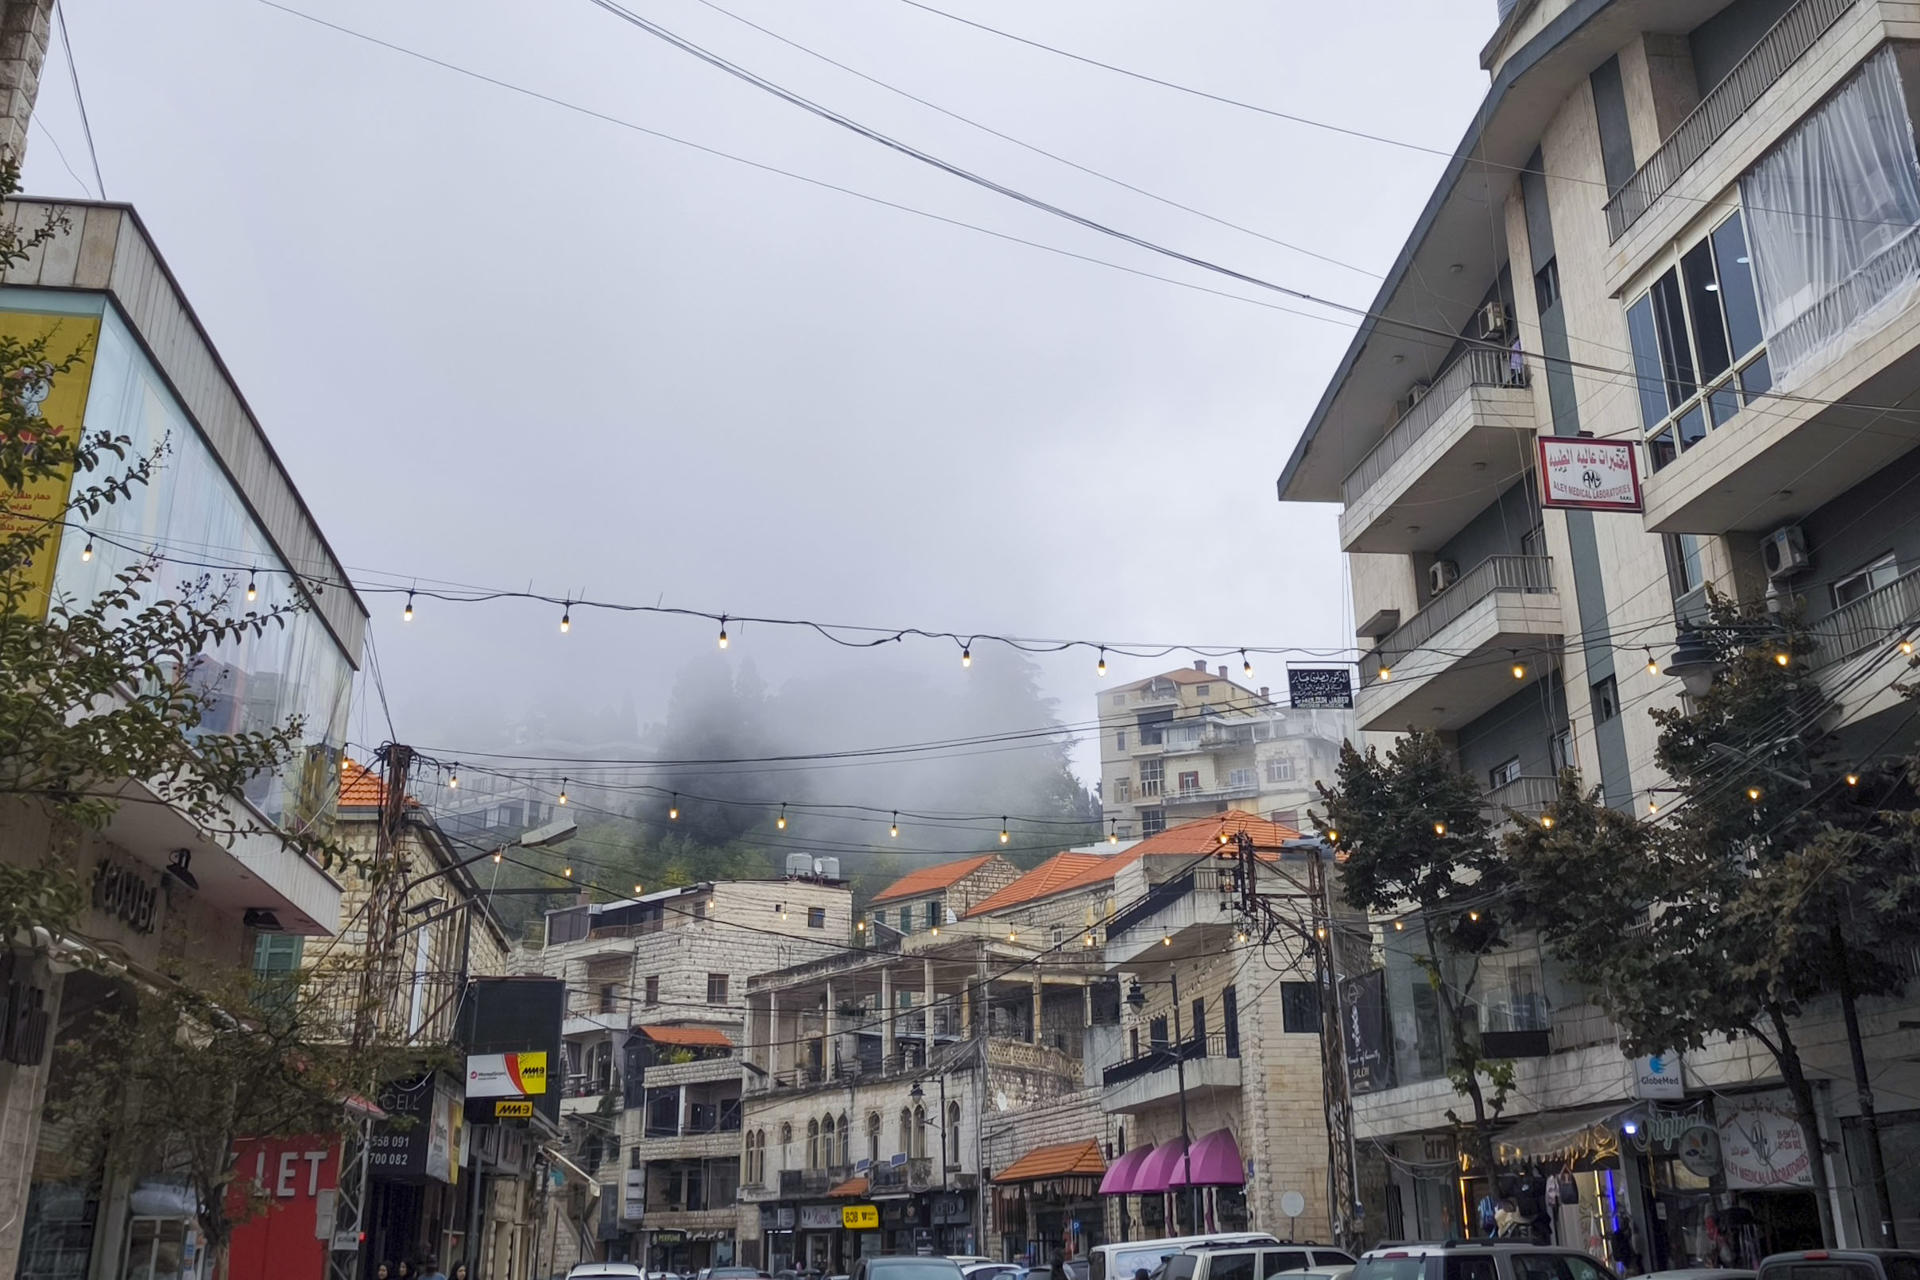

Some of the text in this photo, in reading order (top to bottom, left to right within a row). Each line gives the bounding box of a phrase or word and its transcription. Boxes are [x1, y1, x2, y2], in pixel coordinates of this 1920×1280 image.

[1553, 480, 1631, 499] ALEY MEDICAL LABORATORIES
[1641, 1076, 1680, 1085] GlobeMed
[392, 1136, 409, 1148] 091
[370, 1153, 408, 1165] 700 082
[1739, 1166, 1768, 1184] MEDICAL
